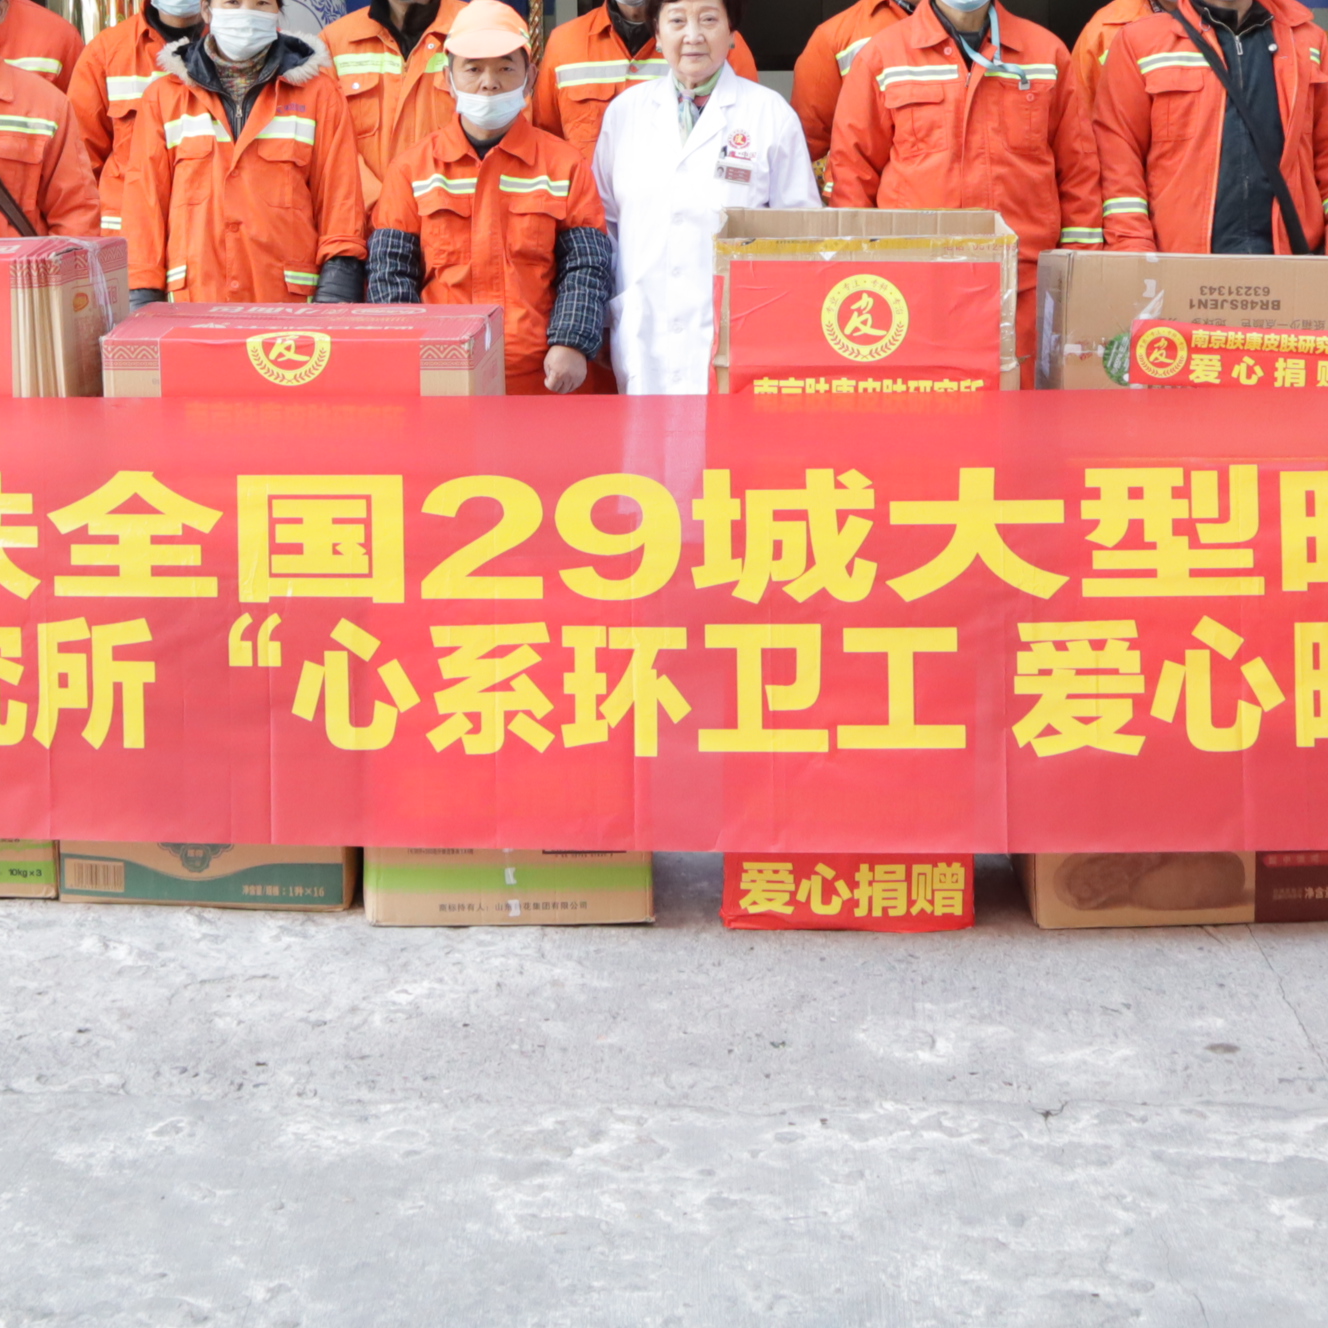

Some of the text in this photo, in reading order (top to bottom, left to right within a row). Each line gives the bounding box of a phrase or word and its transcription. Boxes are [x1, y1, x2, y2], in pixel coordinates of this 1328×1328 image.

[1199, 285, 1271, 297] 63231343
[1188, 298, 1281, 311] BR48SJEN1
[228, 611, 967, 758] “心系环卫工
[738, 861, 966, 918] 爱心捐赠
[438, 900, 588, 913] 商标持有人：山东花集团有限公司
